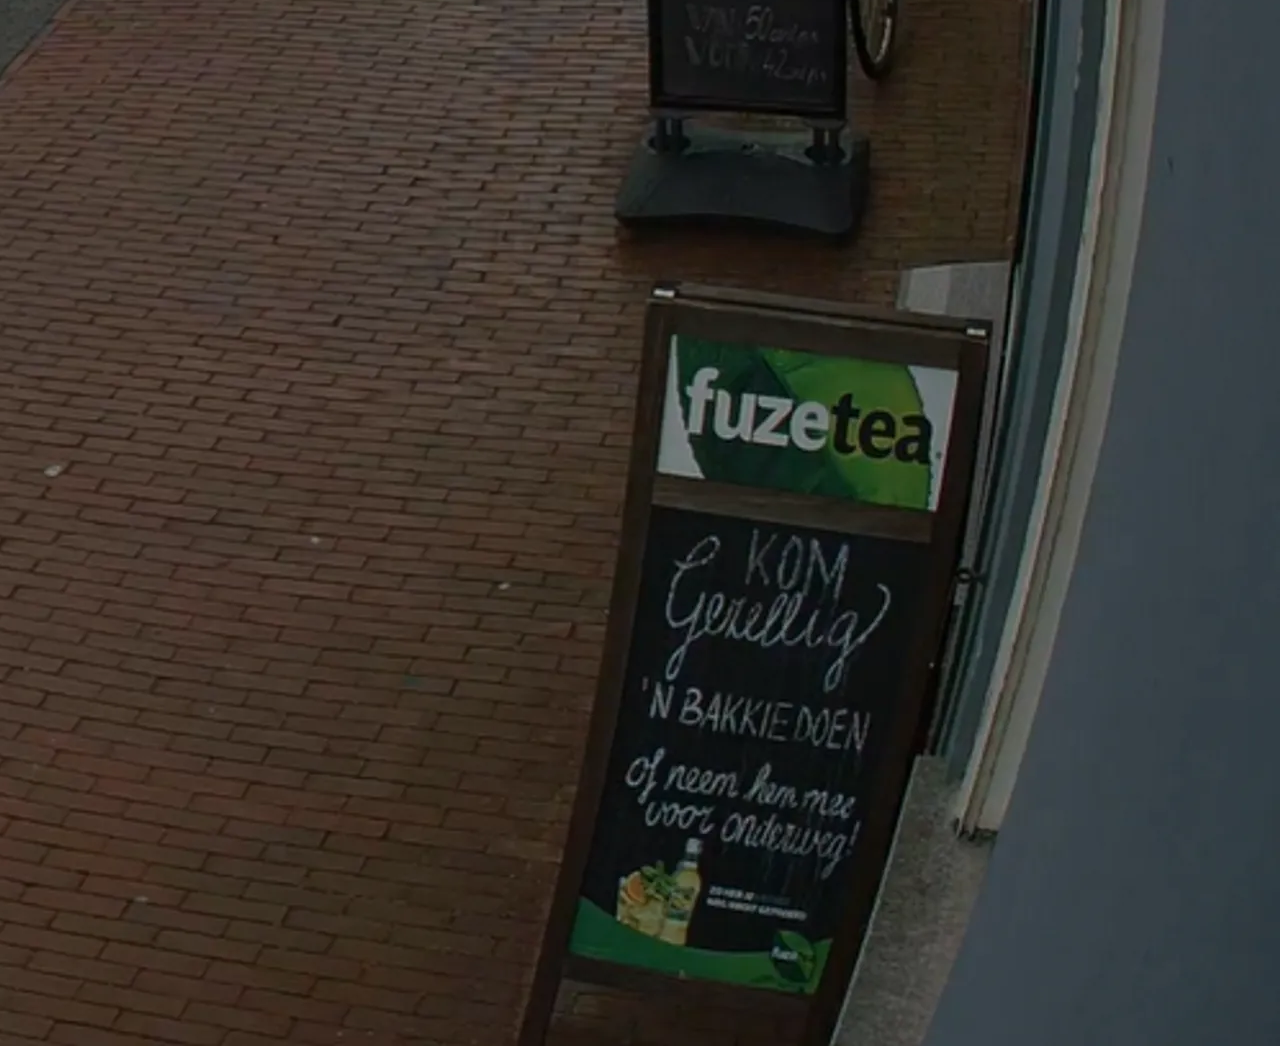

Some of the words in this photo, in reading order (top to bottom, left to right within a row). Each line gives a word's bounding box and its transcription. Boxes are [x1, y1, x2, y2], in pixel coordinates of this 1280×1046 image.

[686, 366, 933, 466] fuzetea
[744, 528, 850, 601] KOM
[642, 676, 675, 720] 'N
[679, 687, 794, 742] BAKKIE
[794, 705, 871, 752] DOEN
[645, 801, 716, 835] voor
[664, 763, 740, 798] neem
[801, 788, 856, 820] mee
